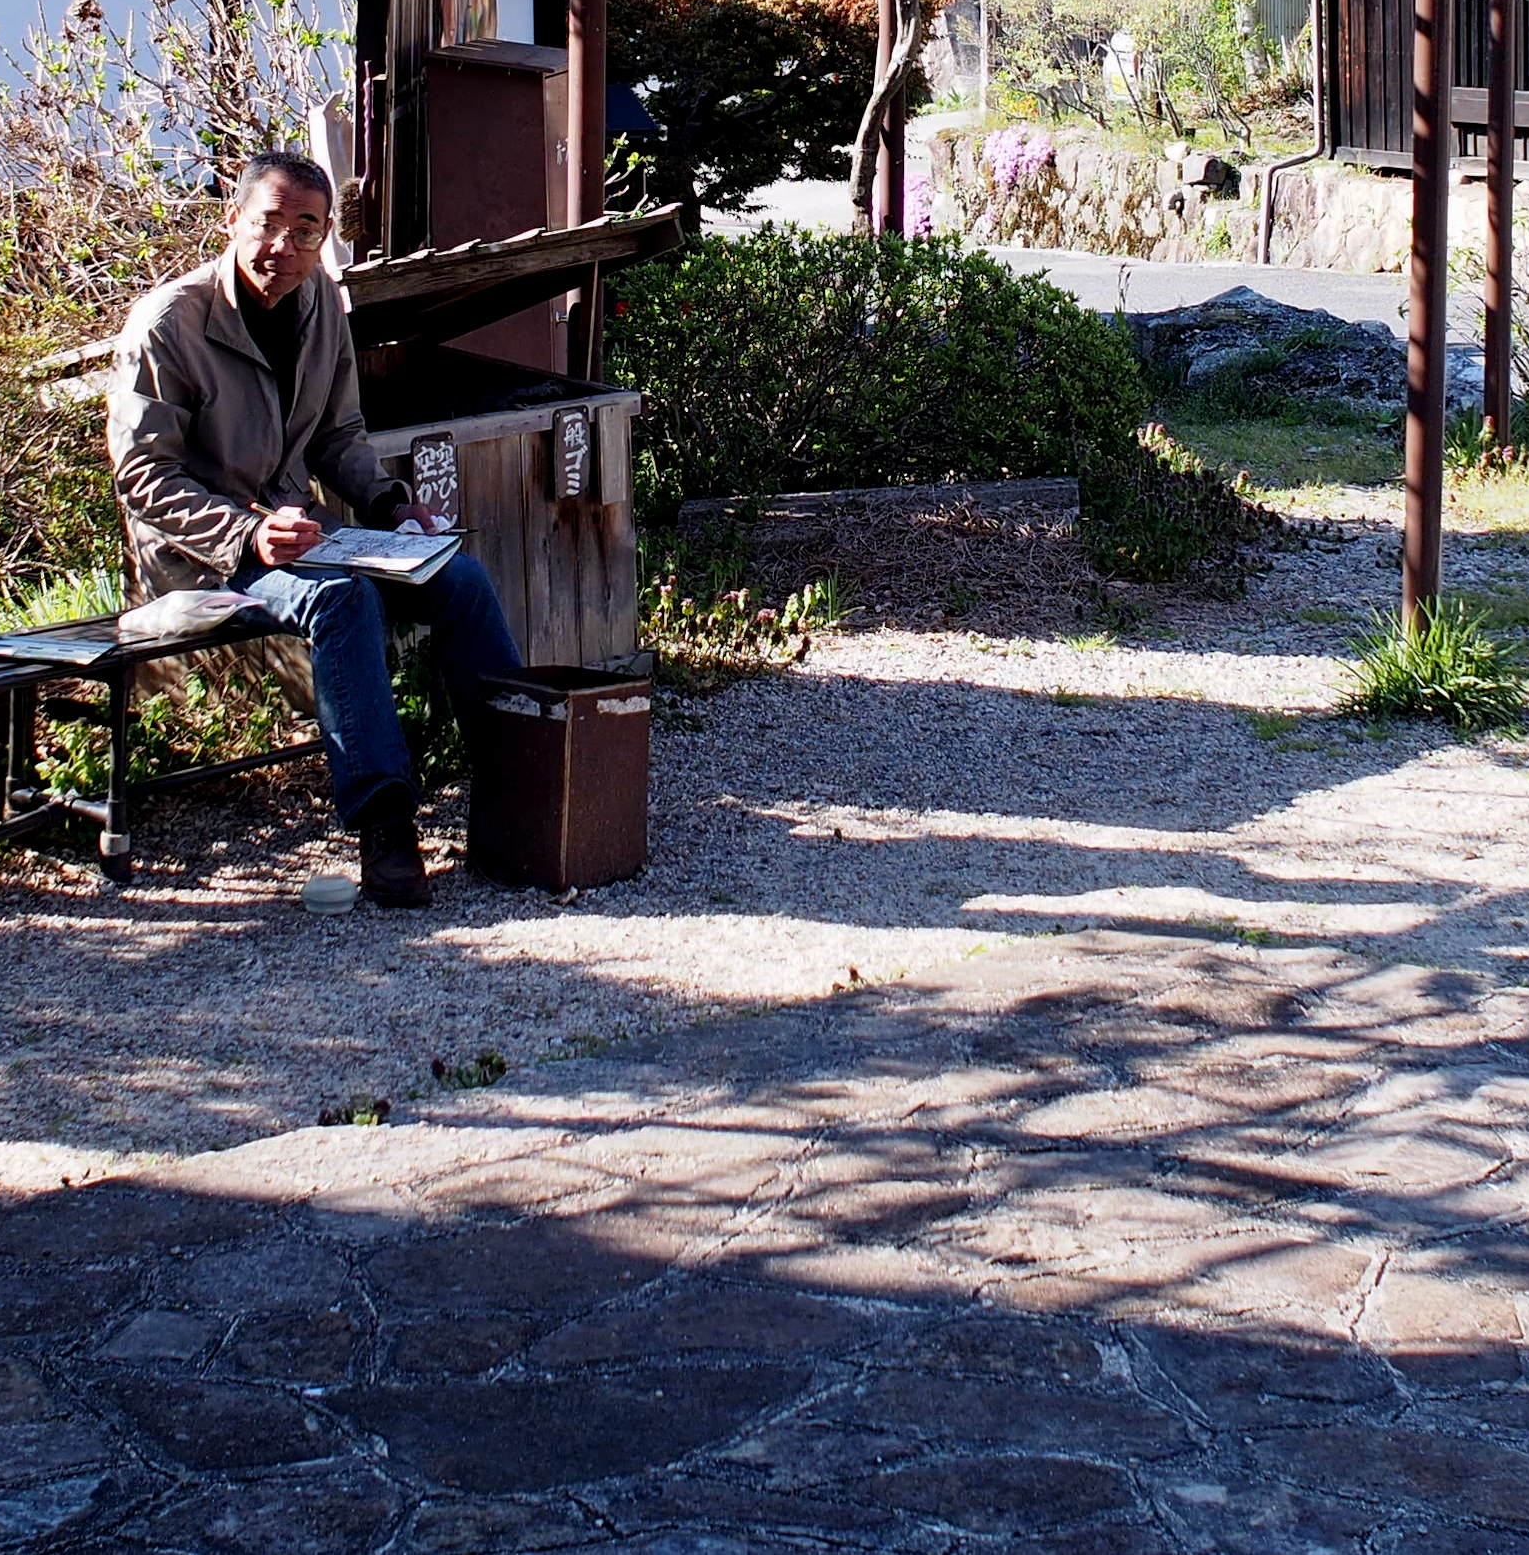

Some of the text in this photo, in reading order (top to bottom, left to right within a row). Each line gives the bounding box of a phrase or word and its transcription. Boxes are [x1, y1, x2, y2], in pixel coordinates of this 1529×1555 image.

[414, 446, 438, 504] 空か
[563, 412, 588, 495] 一般ゴミ
